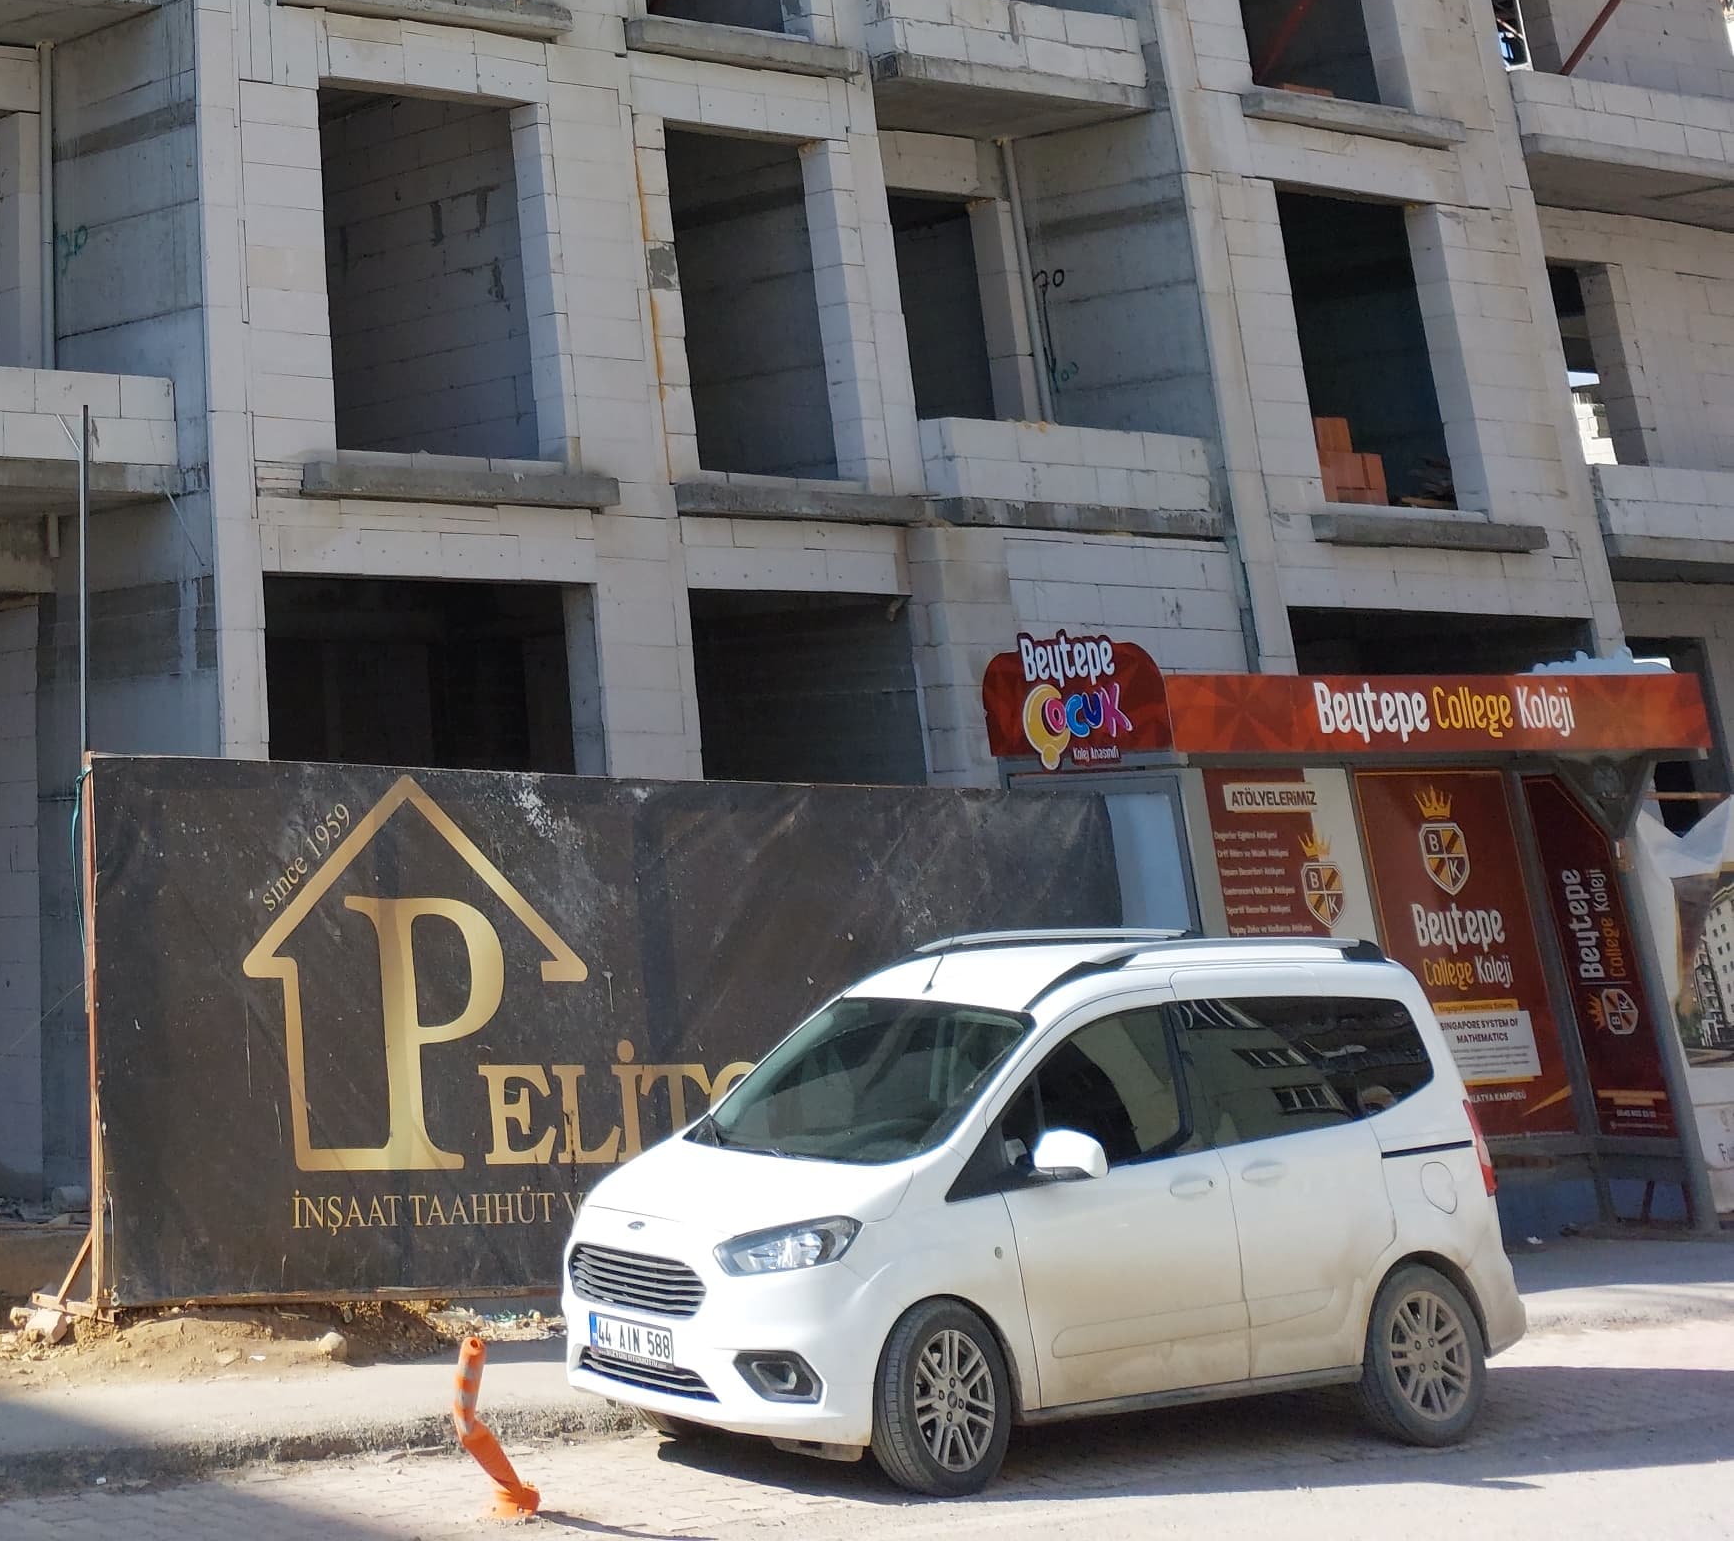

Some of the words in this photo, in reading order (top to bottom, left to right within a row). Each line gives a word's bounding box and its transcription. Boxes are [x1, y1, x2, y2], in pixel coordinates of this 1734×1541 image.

[1019, 635, 1115, 687] Beytepe
[1313, 682, 1430, 743] Beytepe
[1432, 685, 1514, 738] College
[1516, 685, 1576, 737] Koleji
[263, 857, 308, 911] since
[306, 803, 350, 858] 1959
[1428, 834, 1438, 851] B
[1310, 871, 1319, 889] B
[1450, 859, 1461, 879] K
[1586, 868, 1611, 911] Koleji
[1328, 895, 1339, 913] K
[1562, 868, 1606, 979] Beytepe
[1411, 902, 1505, 954] Beytepe
[1602, 917, 1627, 978] College
[1422, 957, 1474, 990] College
[1475, 954, 1514, 988] Koleji
[1456, 1032, 1509, 1044] MATHEMATICS
[292, 1188, 402, 1237] İNŞAAT
[408, 1185, 556, 1226] TAAHHÜT
[598, 1319, 612, 1346] 44
[619, 1324, 641, 1354] AIN
[646, 1330, 671, 1360] 588
